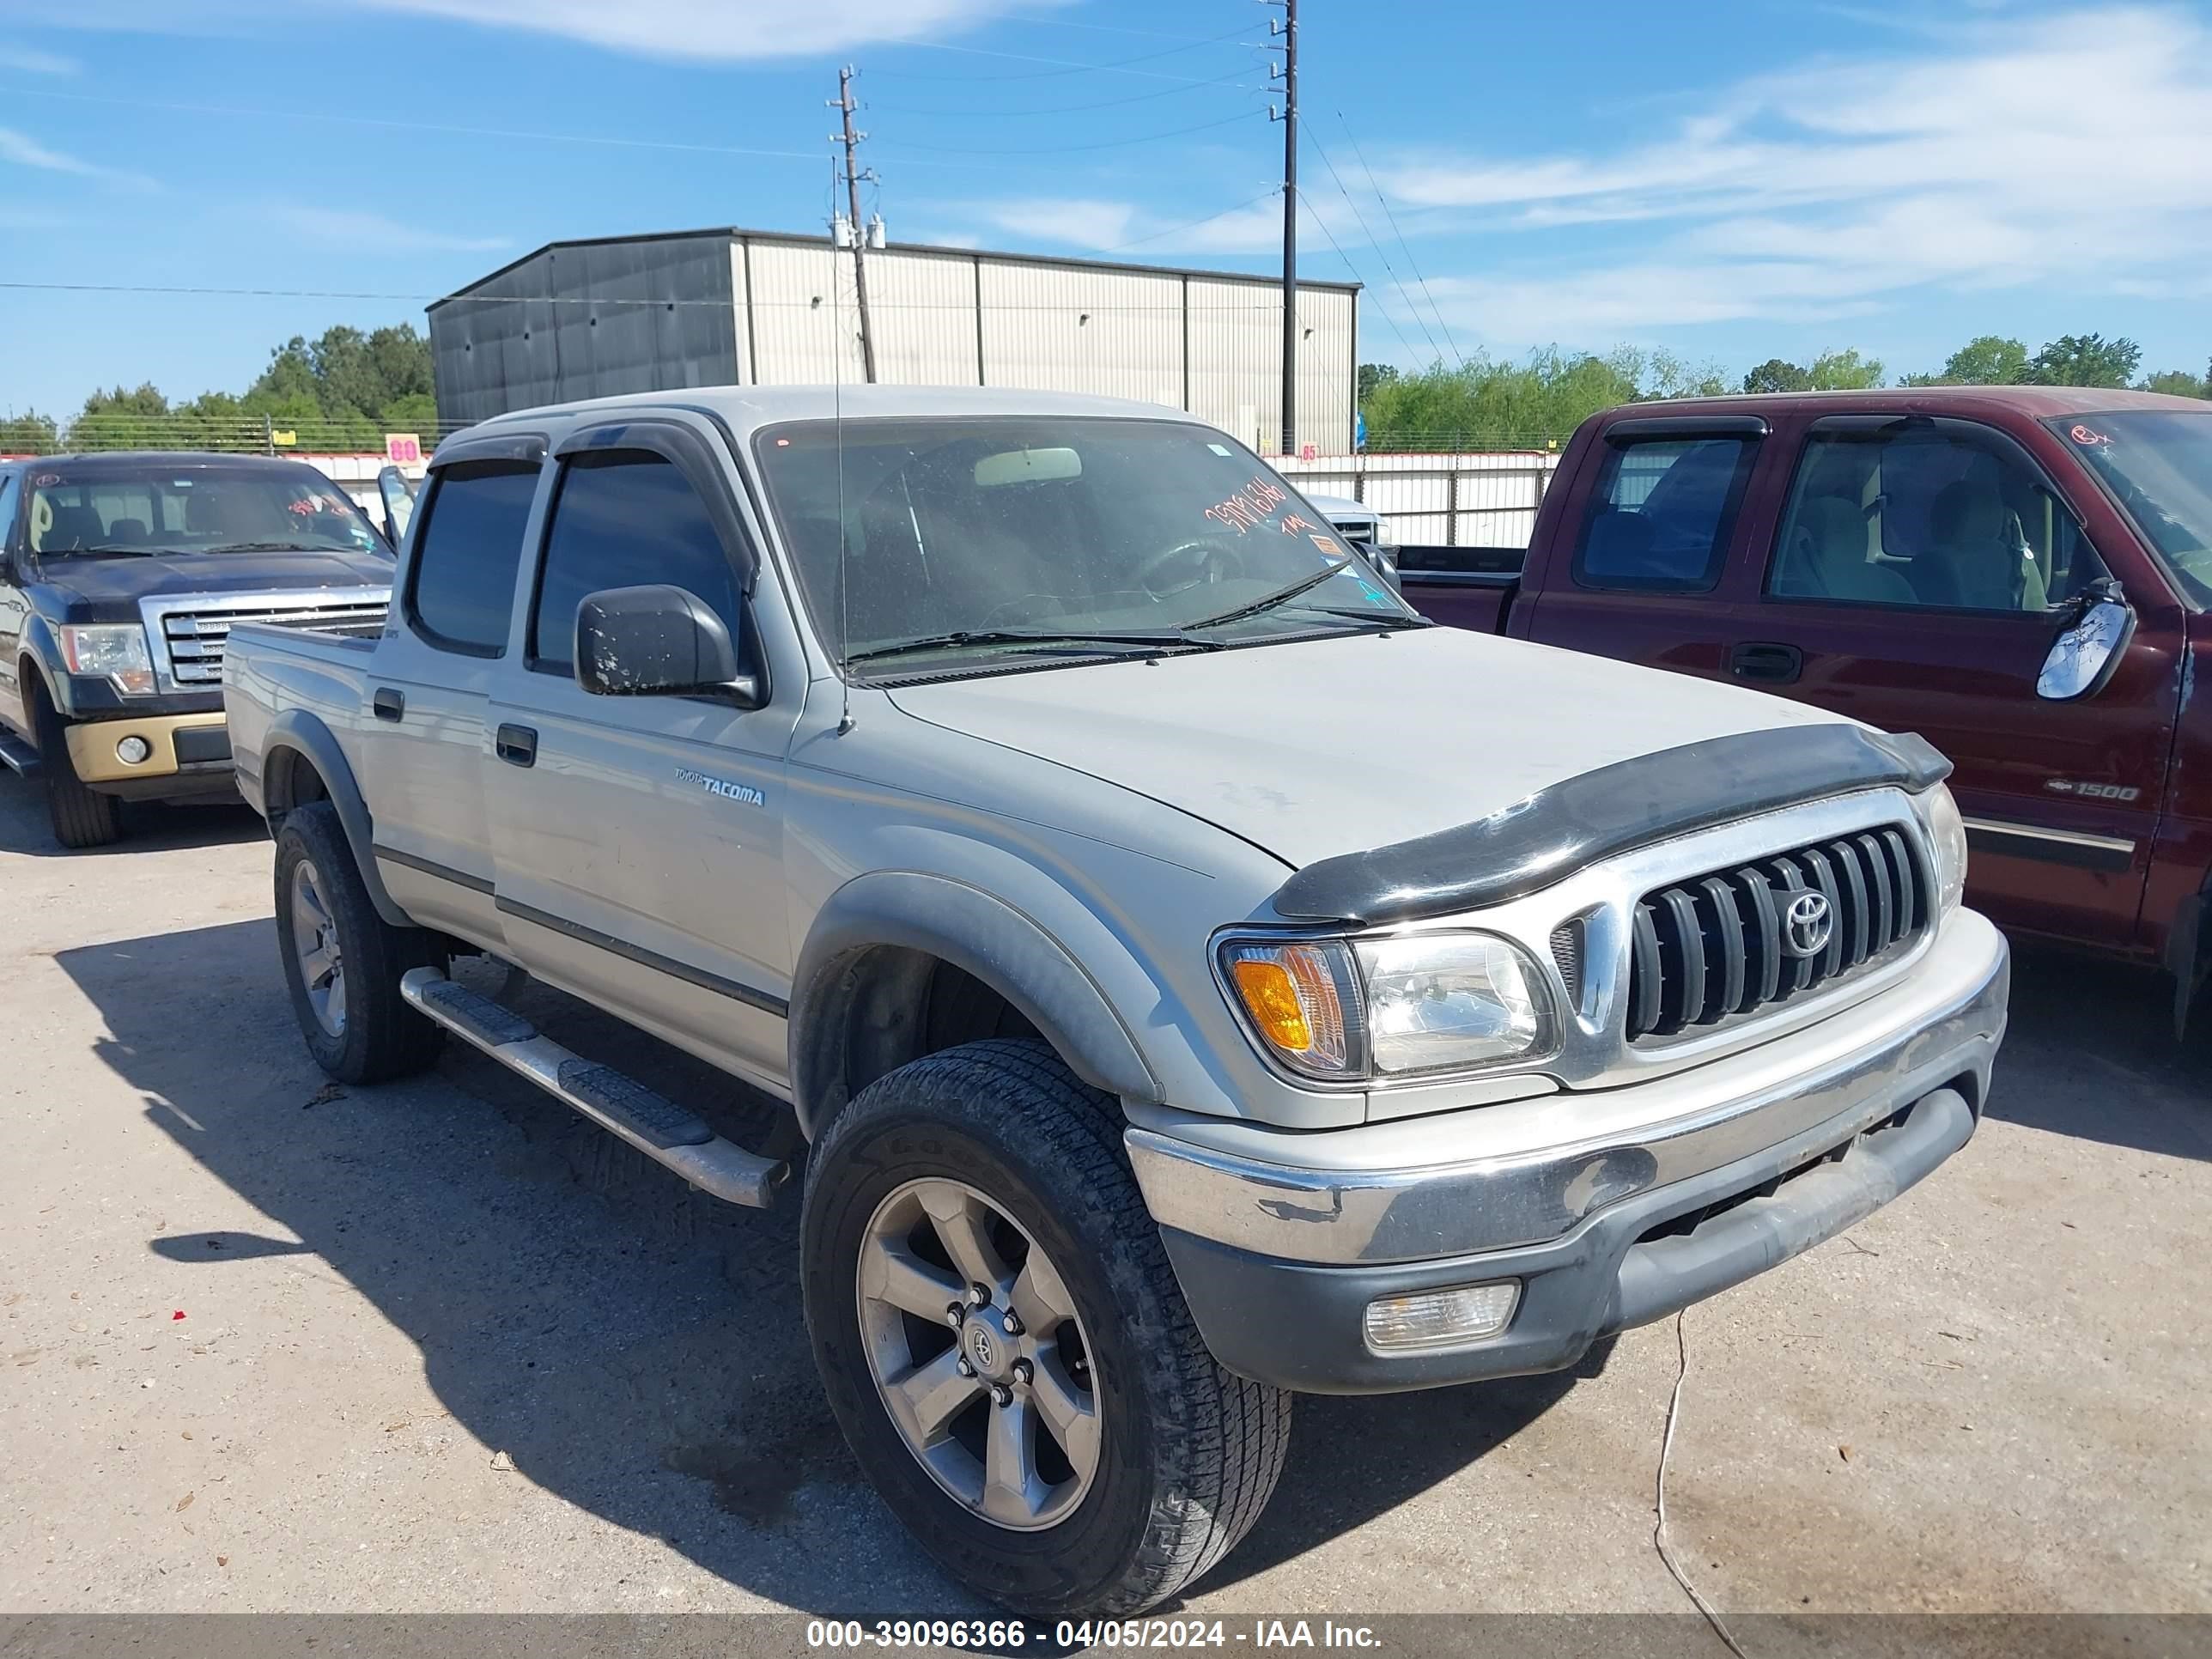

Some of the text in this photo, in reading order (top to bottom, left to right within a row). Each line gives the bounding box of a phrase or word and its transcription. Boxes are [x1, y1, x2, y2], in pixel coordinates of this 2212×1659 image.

[390, 435, 417, 461] 80
[1304, 445, 1316, 460] 85
[674, 768, 764, 807] TOYOTA TACOMA
[2075, 782, 2139, 801] 1500
